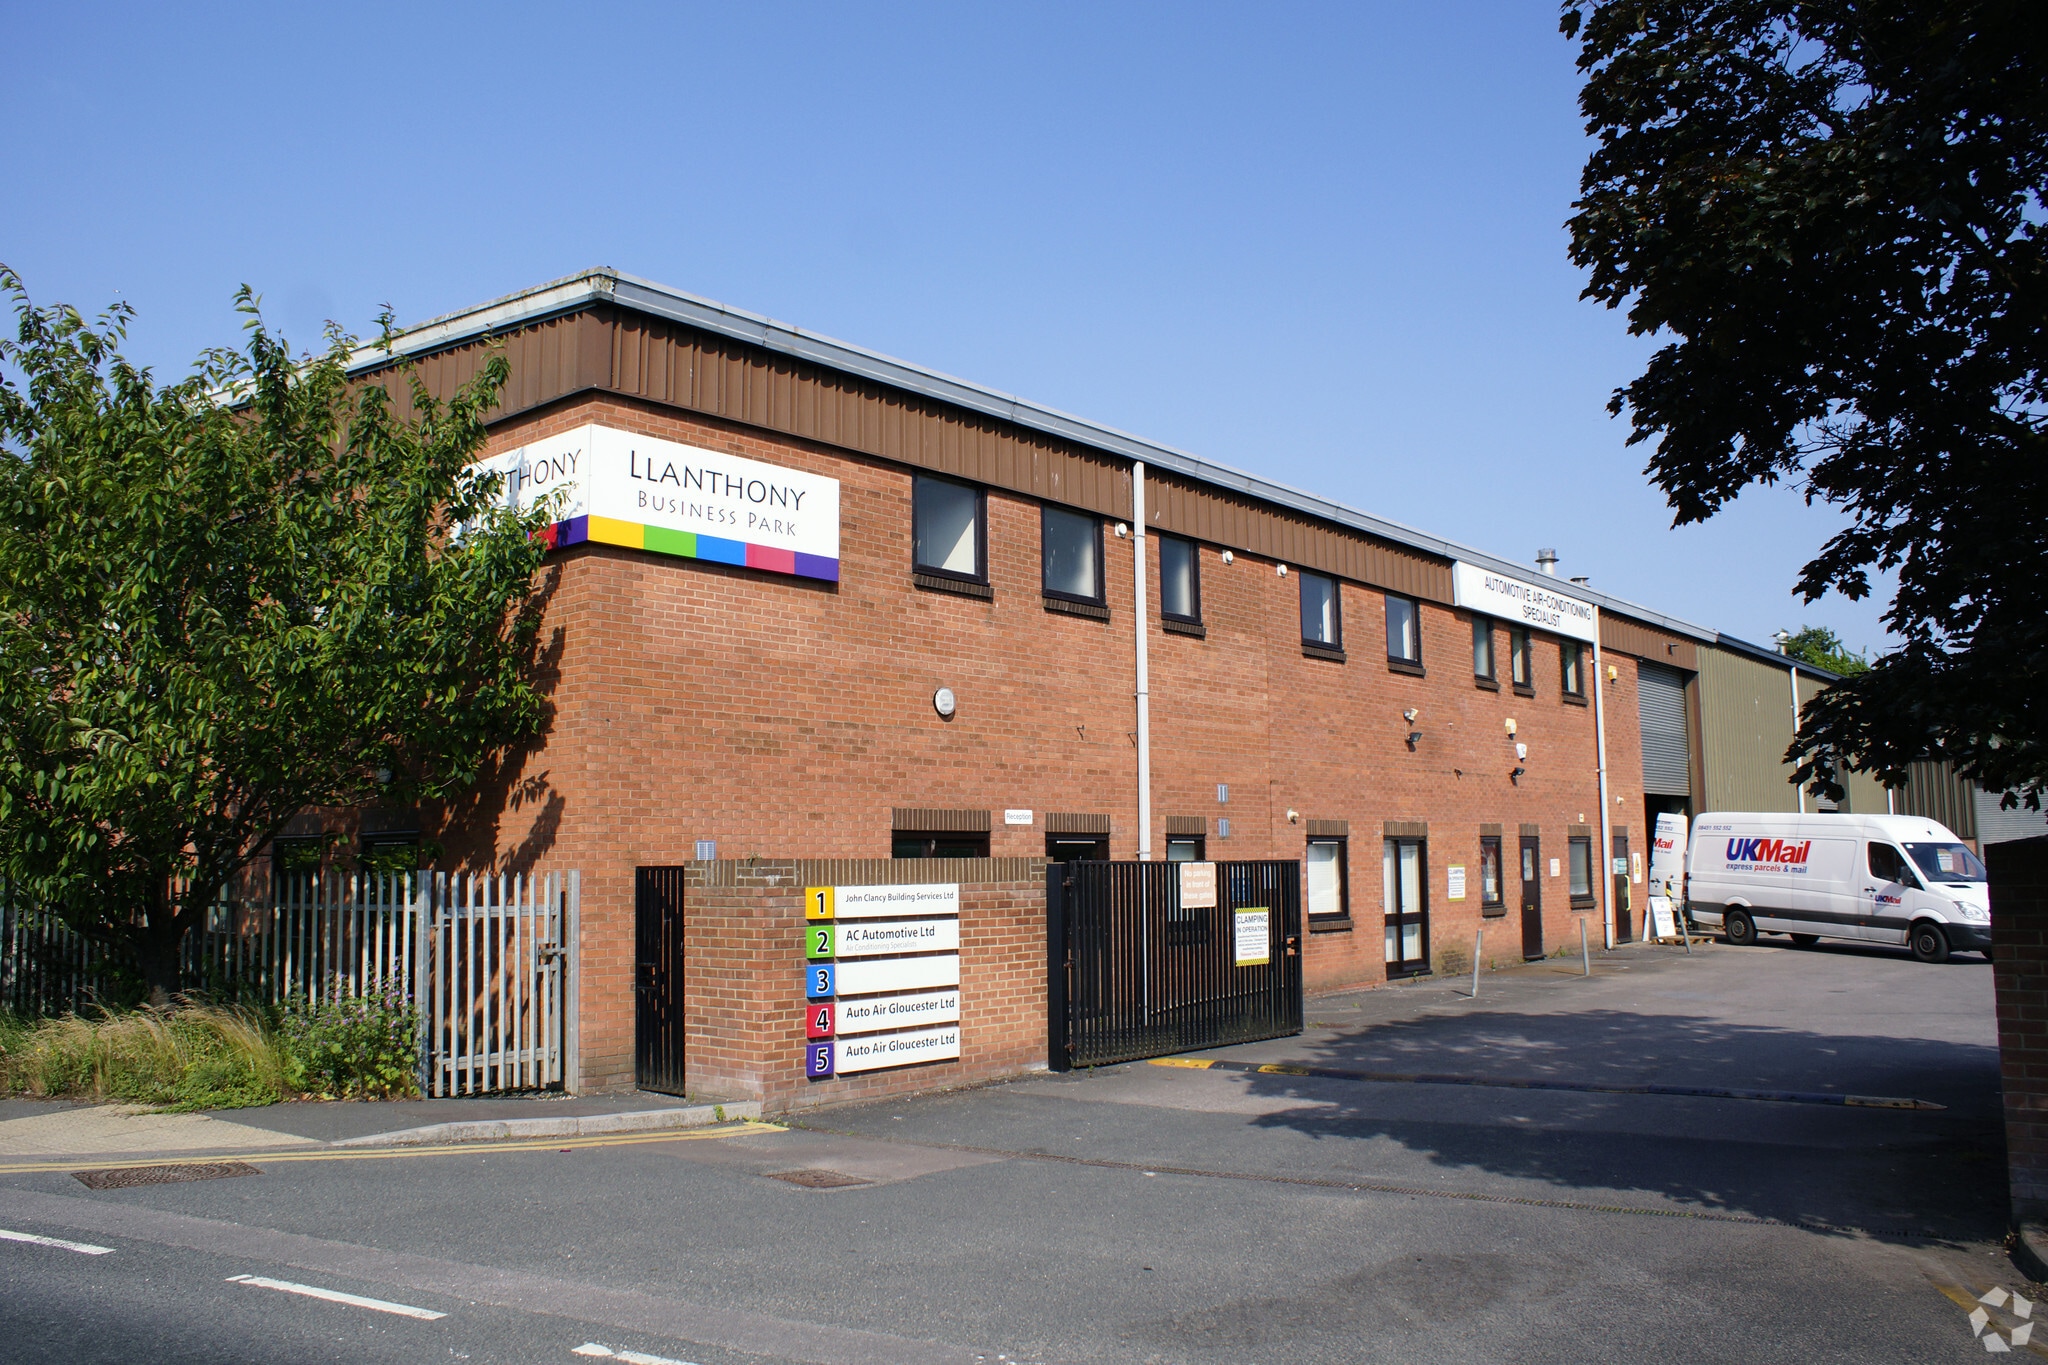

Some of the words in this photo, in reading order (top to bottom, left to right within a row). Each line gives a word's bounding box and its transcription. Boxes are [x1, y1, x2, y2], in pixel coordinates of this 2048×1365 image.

[630, 450, 806, 511] LLANTHONY
[638, 490, 737, 525] BUSINESS
[748, 512, 796, 537] PARK
[1485, 575, 1532, 602] AUTOMOTIVE
[1532, 590, 1591, 620] AIR-CONDITIONING
[1522, 605, 1561, 628] SPECIALIST
[1006, 812, 1032, 821] Reception
[1654, 837, 1674, 849] Mail
[1726, 838, 1812, 864] UKMail
[1193, 869, 1211, 879] parking
[1725, 863, 1753, 871] express
[1754, 863, 1781, 873] parcels
[1783, 865, 1789, 873] &
[1791, 866, 1807, 874] mail
[816, 892, 825, 914] 1
[845, 894, 863, 903] John
[864, 892, 887, 903] Clancy
[887, 892, 916, 903] Building
[917, 891, 943, 900] Services
[943, 891, 954, 899] Ltd
[1237, 915, 1267, 924] CLAMPING
[816, 931, 829, 954] 2
[846, 930, 860, 941] AC
[862, 926, 919, 941] Automotive
[920, 926, 935, 937] Ltd
[854, 942, 890, 952] Conditioning
[890, 941, 917, 950] Specialists
[816, 970, 829, 993] 3
[816, 1008, 829, 1031] 4
[846, 1006, 870, 1019] Auto
[872, 1004, 887, 1016] Air
[888, 999, 939, 1014] Gloucester
[940, 997, 955, 1009] Ltd
[815, 1048, 829, 1072] 5
[846, 1044, 870, 1057] Auto
[872, 1041, 886, 1054] Air
[888, 1035, 939, 1051] Gloucester
[940, 1033, 955, 1045] Ltd
